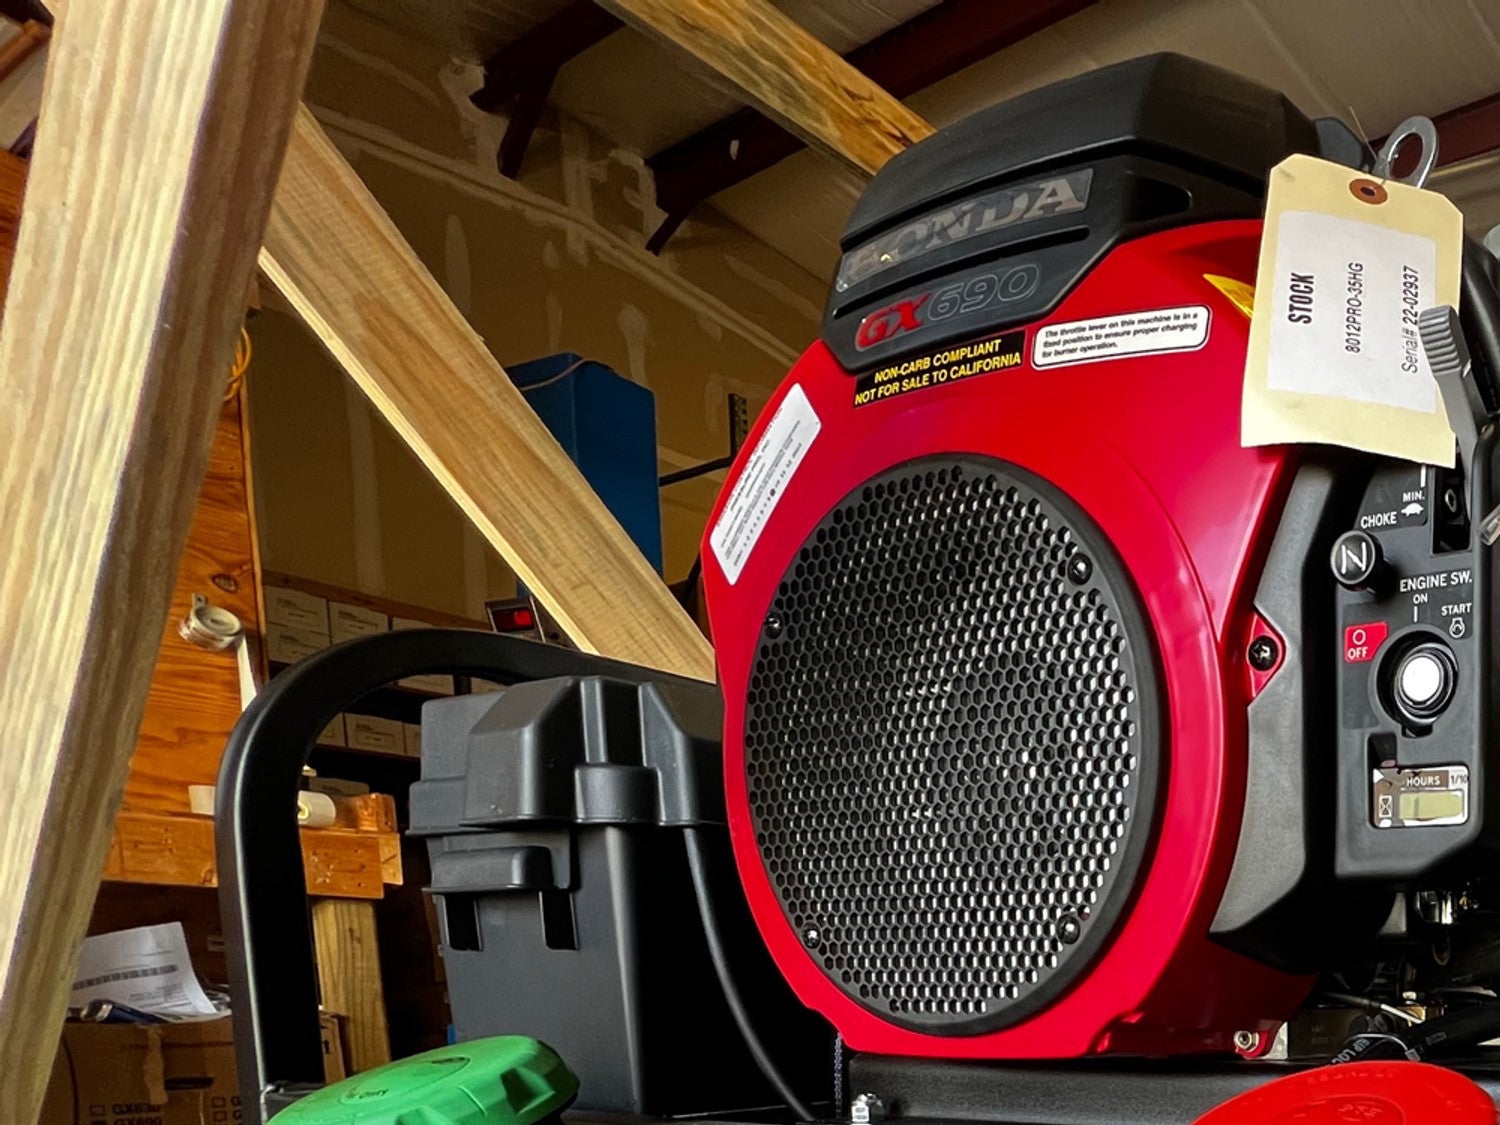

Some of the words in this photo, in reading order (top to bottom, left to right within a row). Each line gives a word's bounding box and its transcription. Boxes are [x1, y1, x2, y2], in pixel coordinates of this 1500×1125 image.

[1287, 272, 1315, 325] STOCK
[1402, 265, 1419, 326] 22-02937
[1344, 261, 1364, 354] 8012PRO-35HG
[1132, 326, 1160, 338] proper
[1160, 321, 1198, 334] charging
[1137, 314, 1172, 326] machine
[1400, 327, 1419, 374] Serial#
[873, 356, 932, 384] NON-CARB
[932, 338, 1003, 367] COMPLIANT
[854, 388, 877, 406] NOT
[876, 381, 901, 399] FOR
[901, 373, 931, 393] SALE
[931, 368, 949, 385] TO
[948, 351, 1023, 380] CALIFORNIA
[1402, 490, 1426, 503] MIN.
[1360, 511, 1398, 530] CHOKE
[1399, 572, 1448, 593] ENGINE
[1449, 569, 1474, 586] SW.
[1412, 592, 1428, 605] ON
[1440, 601, 1473, 617] START
[1347, 645, 1369, 660] OFF
[1406, 774, 1441, 788] HOURS
